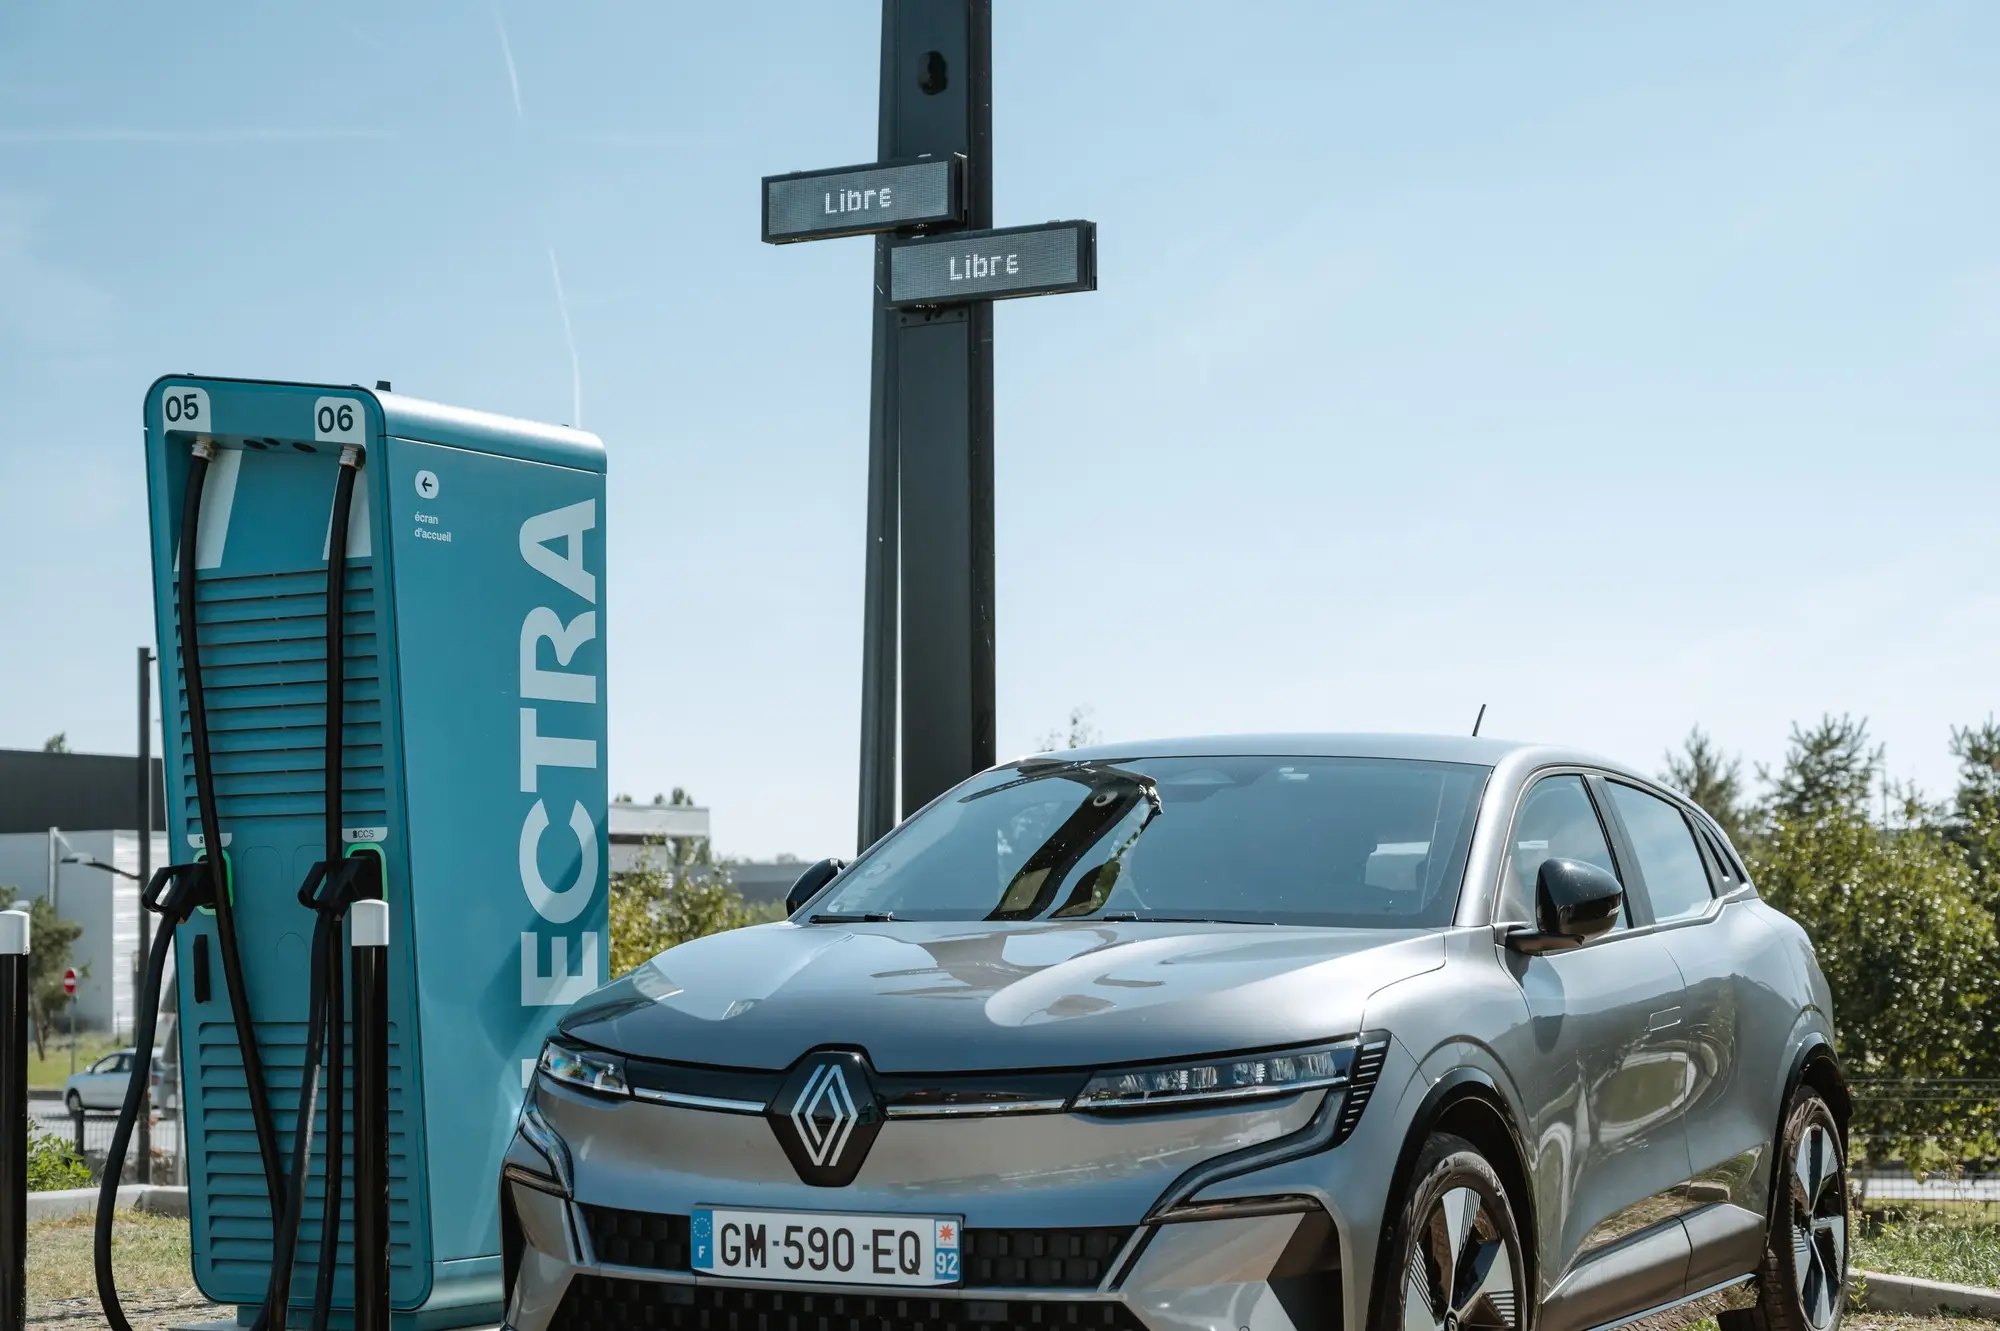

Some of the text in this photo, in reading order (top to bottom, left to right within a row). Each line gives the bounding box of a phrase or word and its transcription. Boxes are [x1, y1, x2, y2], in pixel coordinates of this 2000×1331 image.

[825, 187, 892, 214] Libre
[950, 253, 1019, 280] Libre
[165, 393, 199, 422] 05
[317, 404, 354, 434] 06
[414, 511, 439, 524] écran
[414, 527, 452, 543] d'accueil
[519, 498, 599, 1089] ECTRA
[357, 830, 375, 839] CCS
[698, 1245, 706, 1259] F
[720, 1222, 921, 1276] GM-590-EQ
[935, 1251, 959, 1275] 92
